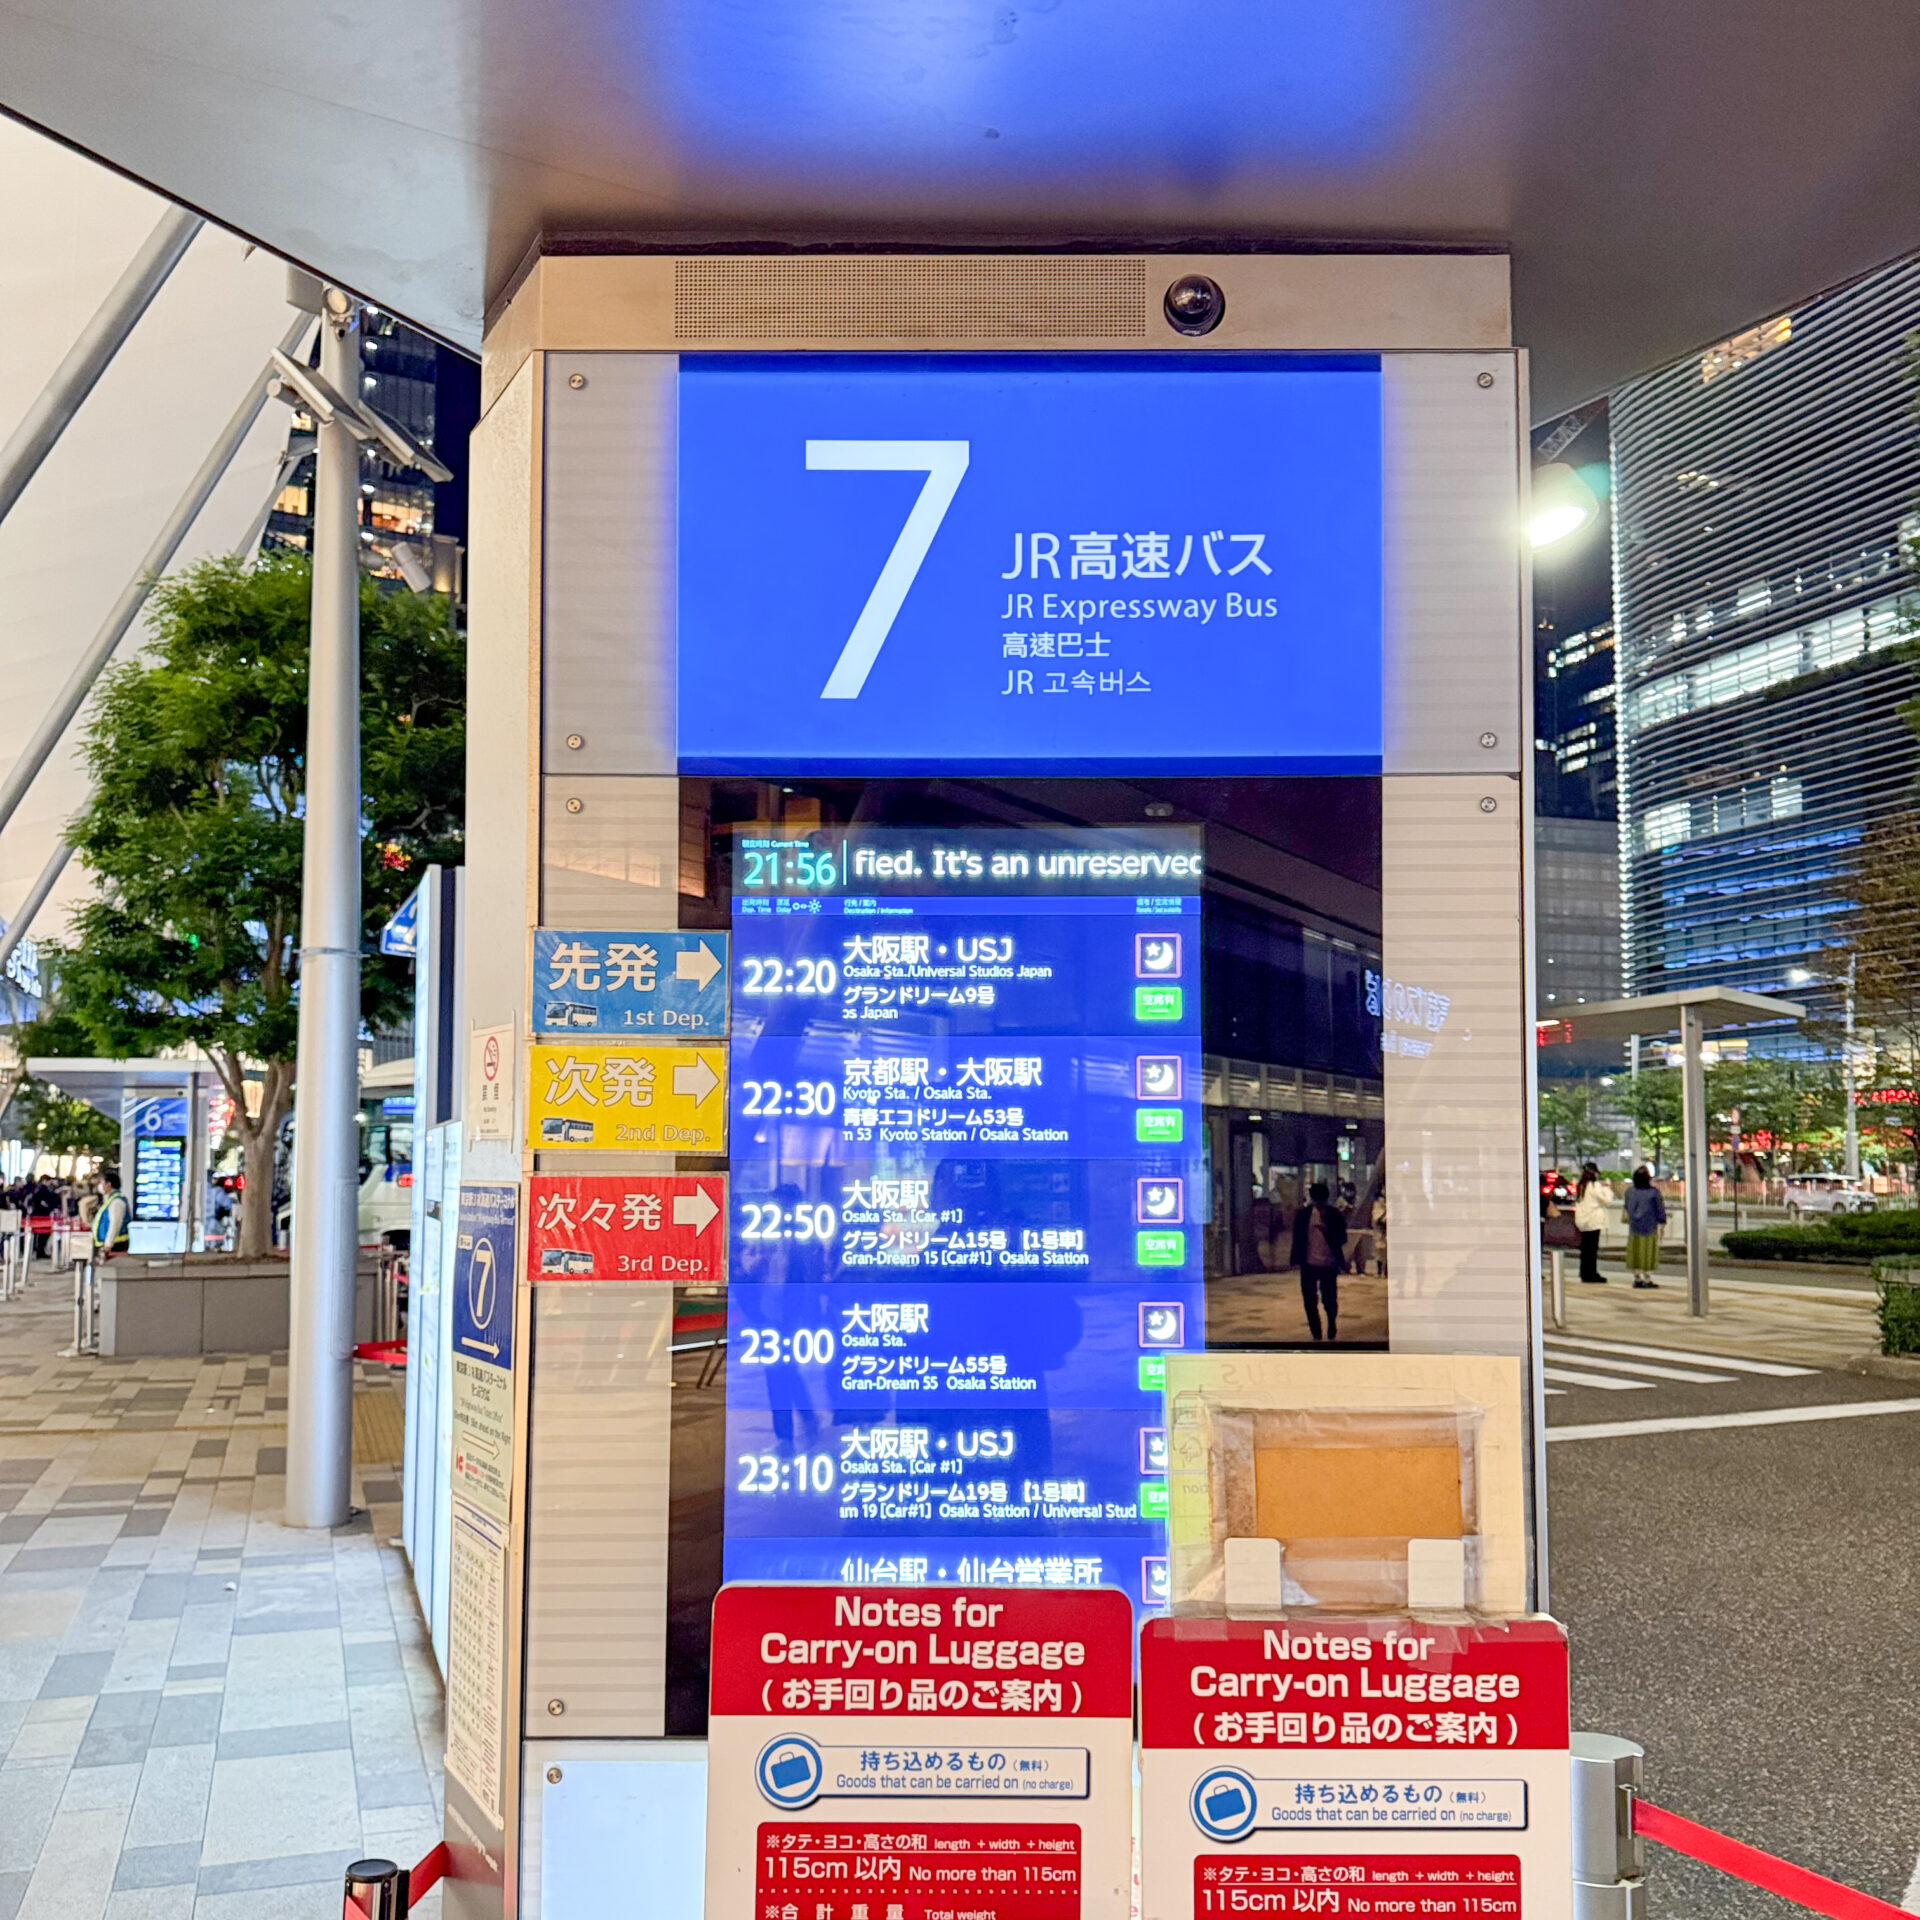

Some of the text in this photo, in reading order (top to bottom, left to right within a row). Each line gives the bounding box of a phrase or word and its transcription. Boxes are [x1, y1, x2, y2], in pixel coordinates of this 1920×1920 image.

[1002, 531, 1272, 580] JR高速バス
[806, 440, 969, 699] 7
[1002, 593, 1277, 624] JR Expressway Bus
[1002, 633, 1111, 658] 高速巴士
[1002, 669, 1151, 695] JR 고속버스
[744, 852, 836, 885] 21:56
[855, 851, 922, 875] fied.
[933, 852, 982, 875] It's
[991, 855, 1029, 875] an
[843, 936, 1012, 963] 大阪駅・USJ
[549, 942, 658, 991] 先発
[743, 960, 836, 993] 22:20
[843, 966, 880, 977] Osaka
[969, 965, 1014, 977] Studios
[1017, 966, 1052, 979] Japan
[843, 986, 995, 1004] グランドリーム9号
[624, 1010, 709, 1027] 1st Dep.
[861, 1007, 898, 1020] Japan
[545, 1056, 656, 1107] 次発
[843, 1058, 1041, 1086] 京都駅・大阪駅
[743, 1082, 836, 1115] 22:30
[843, 1087, 991, 1101] Kyoto Sta. Osaka Sta.
[144, 1105, 161, 1131] 6
[843, 1109, 1023, 1126] 青春エコドリーム53号
[616, 1124, 710, 1142] 2nd Dep.
[856, 1129, 1068, 1142] 53 Kyoto Station Osaka Station
[843, 1181, 929, 1209] 大阪駅
[538, 1193, 662, 1231] 次々発
[741, 1205, 835, 1239] 22:50
[843, 1210, 963, 1223] Osaka Sta. [Car #1]
[843, 1231, 1007, 1248] グランドリーム15号
[618, 1255, 708, 1274] 3rd Dep.
[843, 1252, 1088, 1266] Gran-Dream 15 [Car#1] Osaka Station
[476, 1249, 492, 1317] 7
[843, 1305, 929, 1333] 大阪駅
[740, 1330, 833, 1363] 23:00
[842, 1335, 907, 1346] Osaka Sta.
[843, 1357, 1007, 1374] グランドリーム55号
[843, 1377, 1036, 1389] Gran-Dream 55 Osaka Station
[841, 1430, 1012, 1458] 大阪駅・USJ
[739, 1456, 832, 1491] 23:10
[841, 1460, 963, 1475] Osaka Sta. [Car #1]
[841, 1483, 1008, 1502] グランドリーム19号
[862, 1505, 1136, 1520] 19 [Car#1] Osaka Station Universal Stud
[835, 1597, 1003, 1627] Notes for
[761, 1634, 1085, 1670] Carry-on Luggage
[1264, 1631, 1435, 1660] Notes for
[1190, 1667, 1520, 1702] Carry-on Luggage
[861, 1752, 1005, 1772] 持ち込めるもの
[836, 1775, 1073, 1791] Goods that can be carried on (no charge)
[1295, 1785, 1442, 1804] 持ち込めるもの
[1272, 1808, 1511, 1822] Goods that can be carried on (no charge)
[934, 1838, 970, 1850] length
[990, 1838, 1020, 1850] width
[1039, 1838, 1075, 1850] height
[766, 1857, 1076, 1881] 115cm 以内 No more than 115cm
[1372, 1870, 1408, 1882] length
[1427, 1870, 1458, 1881] width
[1477, 1870, 1514, 1882] height
[1203, 1889, 1516, 1913] 115cm 以内 No more than 115cm
[925, 1909, 954, 1920] Total
[958, 1909, 995, 1920] weight
